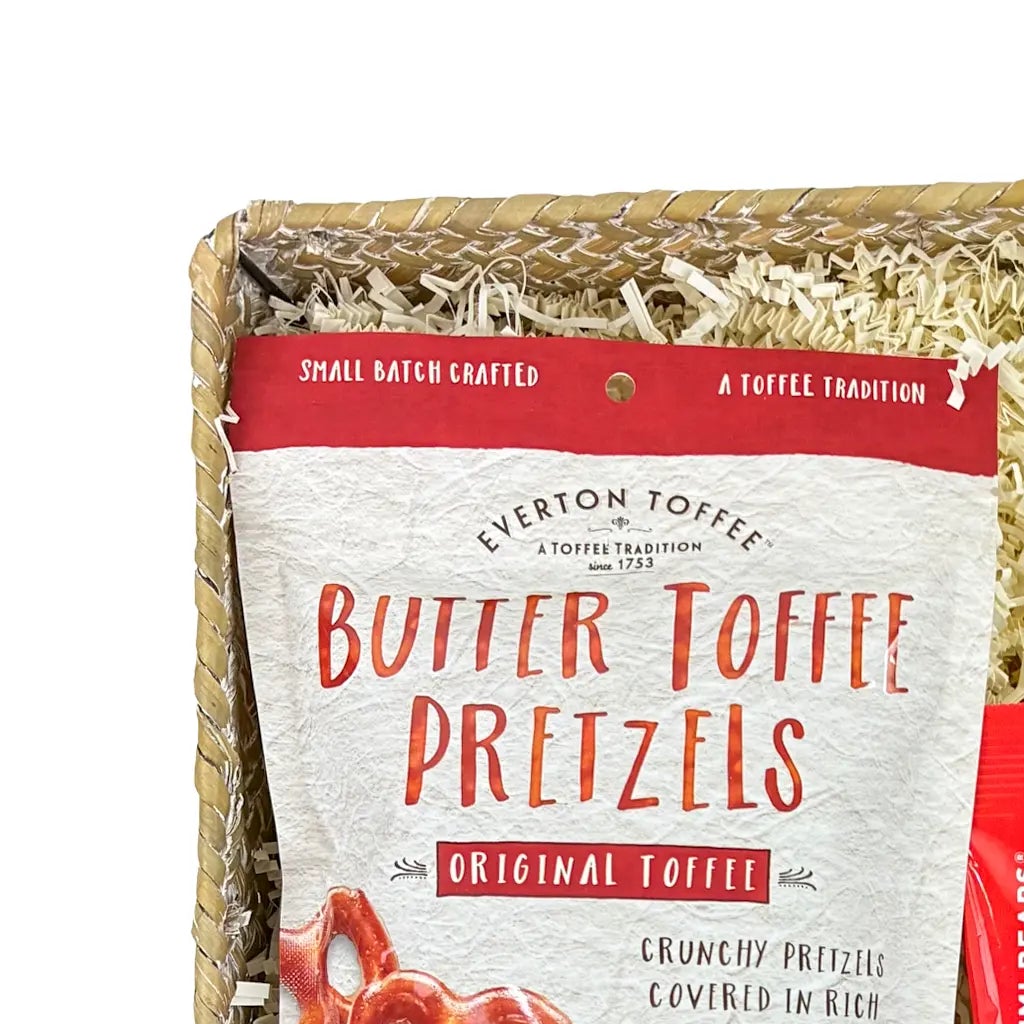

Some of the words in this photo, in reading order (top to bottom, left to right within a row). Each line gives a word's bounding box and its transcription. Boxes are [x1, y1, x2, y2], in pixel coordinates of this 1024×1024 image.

[299, 359, 364, 382] SMALL
[374, 360, 441, 384] BATCH
[450, 362, 539, 387] CRAFTED
[718, 373, 731, 396] A
[741, 373, 815, 396] TOFFEE
[823, 376, 925, 404] TRADITION
[476, 488, 626, 553] EVERTON
[538, 543, 546, 555] A
[551, 542, 609, 555] TOFFEE
[616, 542, 702, 555] TRADITION
[588, 560, 613, 571] since
[618, 558, 654, 570] 1753
[318, 583, 609, 688] BUTTER
[664, 582, 914, 694] TOFFEE
[404, 695, 806, 813] PRETZELS
[449, 851, 618, 888] ORIGINAL
[640, 853, 758, 893] TOFFEE
[641, 935, 768, 967] CRUNCHY
[783, 943, 886, 978] PRETZELS
[648, 981, 771, 1013] COVERED
[785, 986, 811, 1015] IN
[824, 988, 880, 1020] RICH
